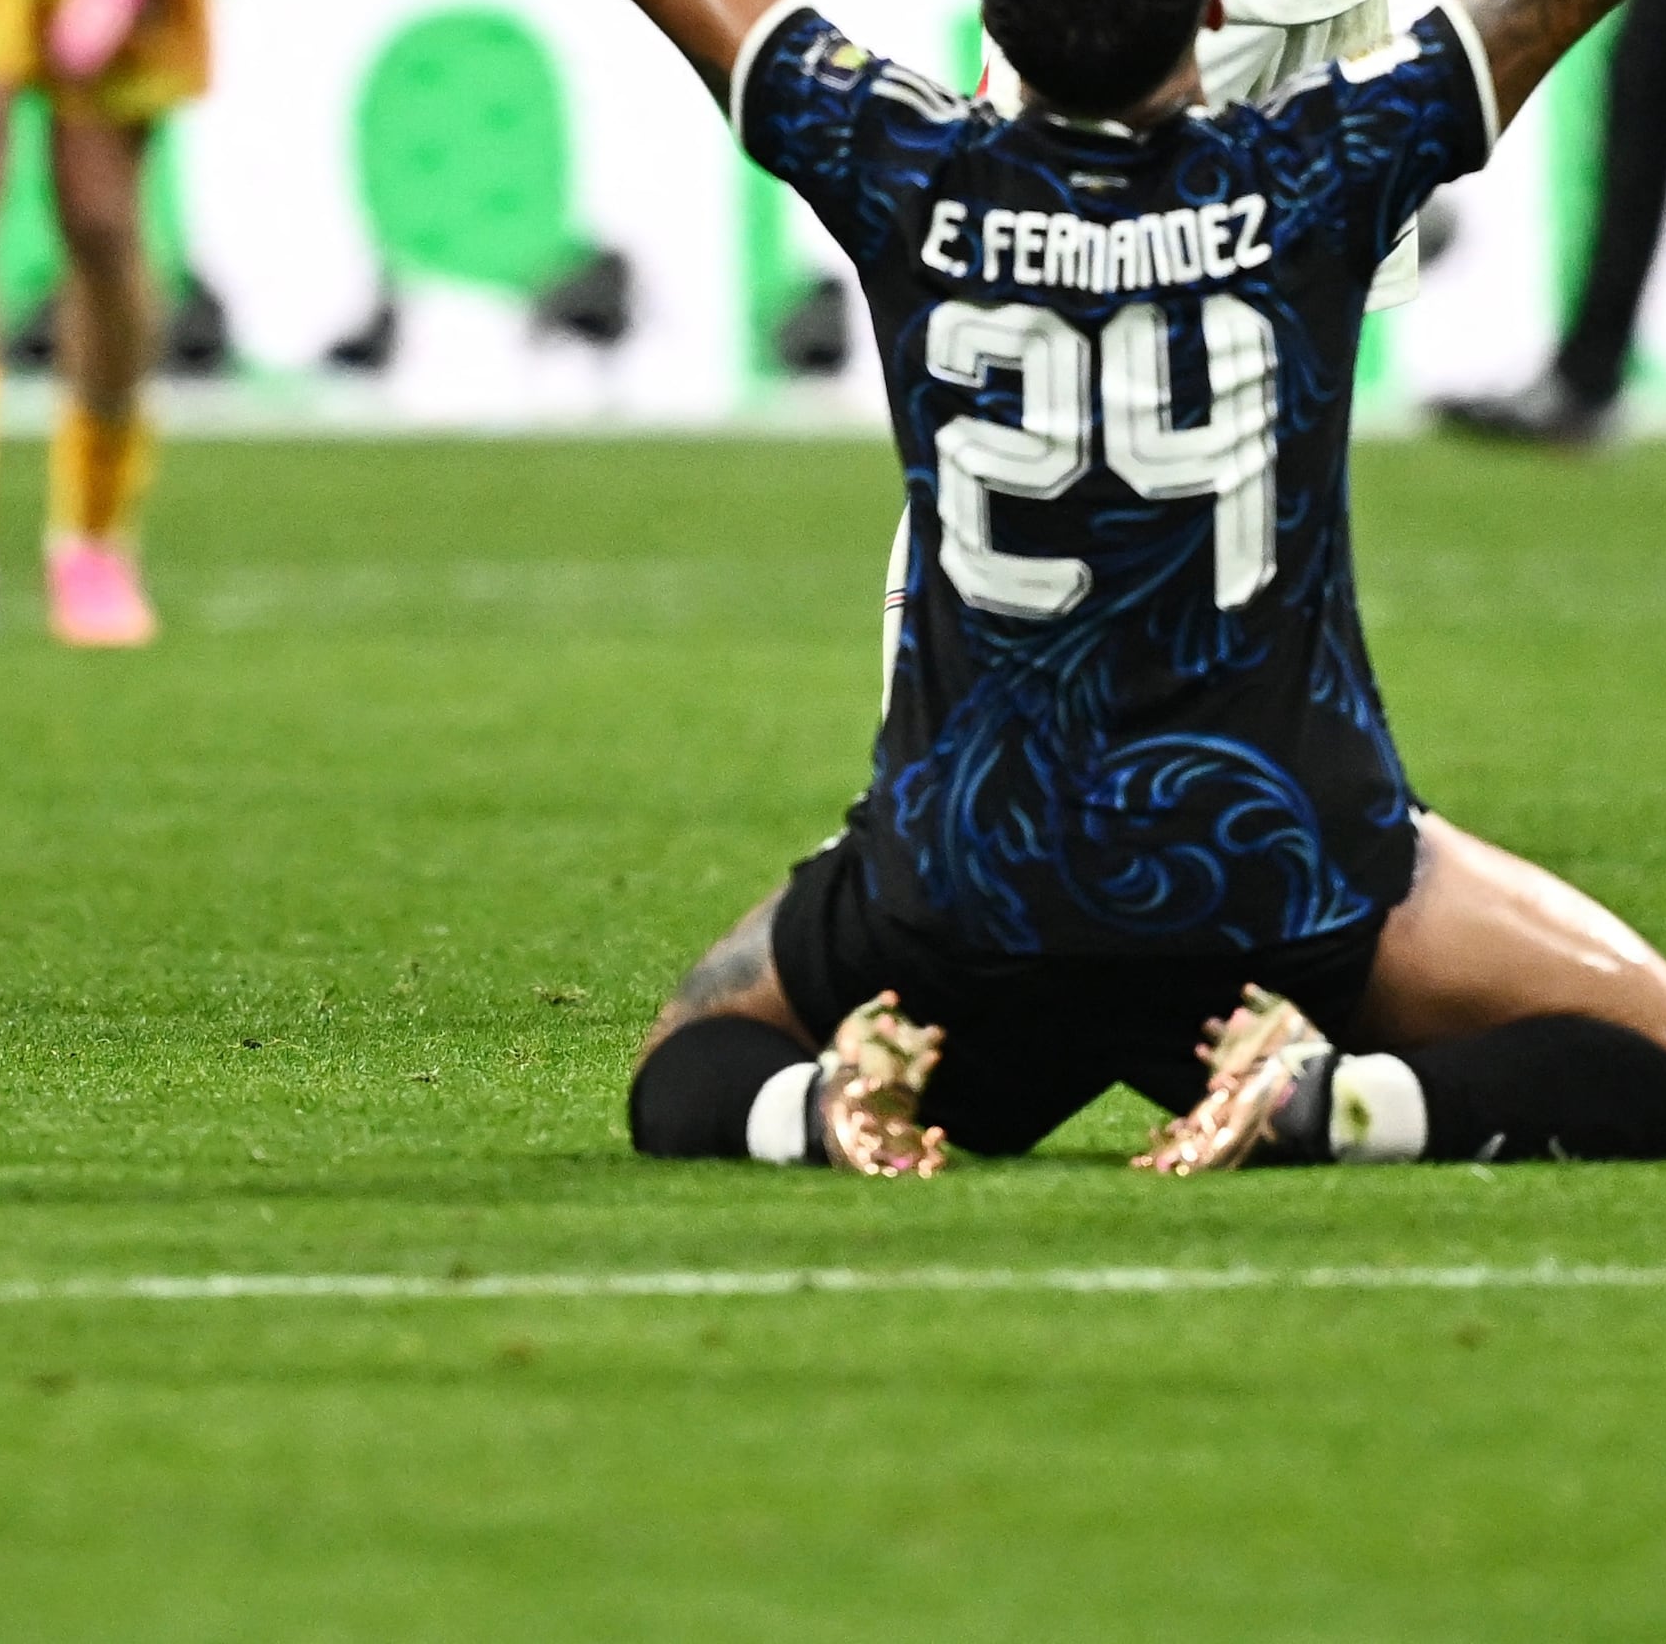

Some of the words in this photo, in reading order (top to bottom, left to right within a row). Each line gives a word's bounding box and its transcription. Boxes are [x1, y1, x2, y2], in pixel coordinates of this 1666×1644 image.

[920, 192, 970, 279] E.
[981, 192, 1274, 296] FERNANDEZ
[924, 292, 1280, 621] 24
